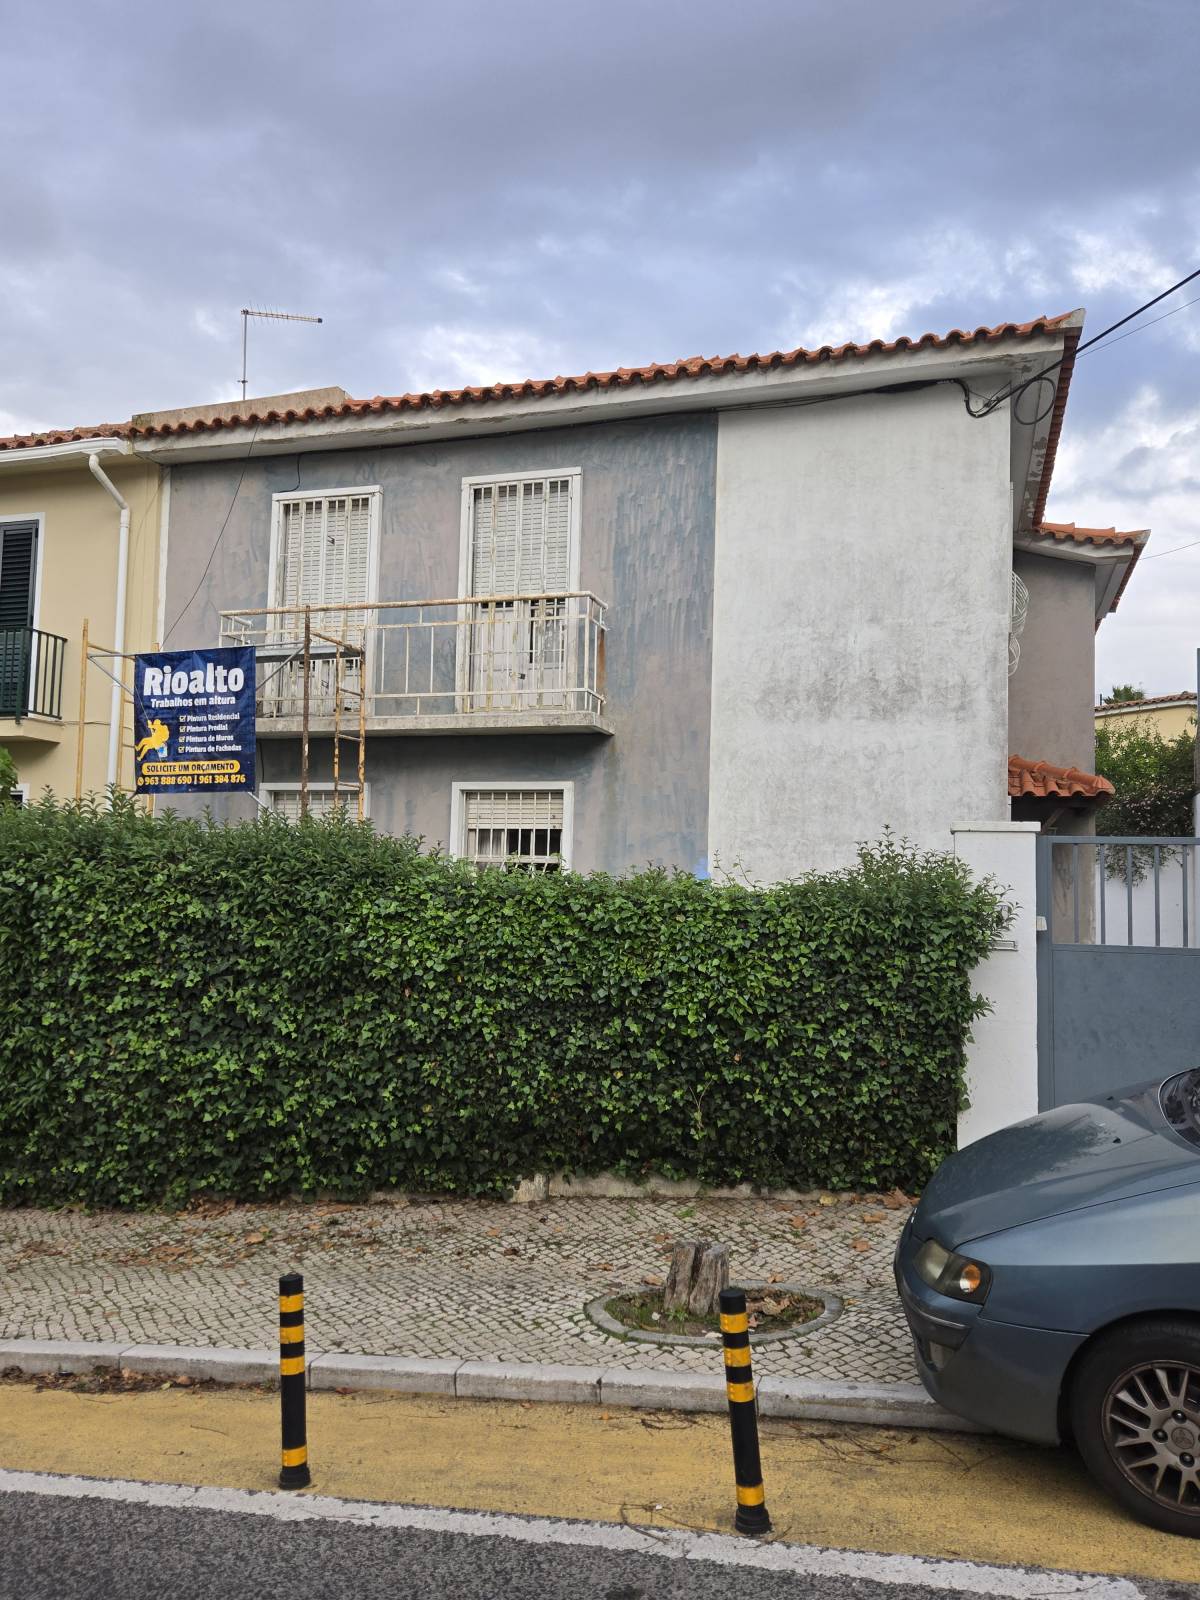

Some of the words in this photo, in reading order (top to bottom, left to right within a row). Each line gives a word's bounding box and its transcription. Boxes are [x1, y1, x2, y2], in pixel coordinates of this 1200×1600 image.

[144, 663, 244, 696] Rioalto
[151, 697, 193, 708] Trabalhos
[194, 698, 207, 706] em
[209, 695, 236, 705] altura
[208, 712, 240, 721] Residencial
[208, 723, 228, 731] Predial
[185, 745, 207, 753] Pintura
[146, 764, 177, 773] SOLICITE
[178, 764, 190, 772] UM
[191, 762, 235, 772] ORÇAMENTO
[144, 777, 159, 785] 963
[177, 776, 192, 785] 690
[199, 775, 212, 784] 961
[230, 774, 246, 783] 876
